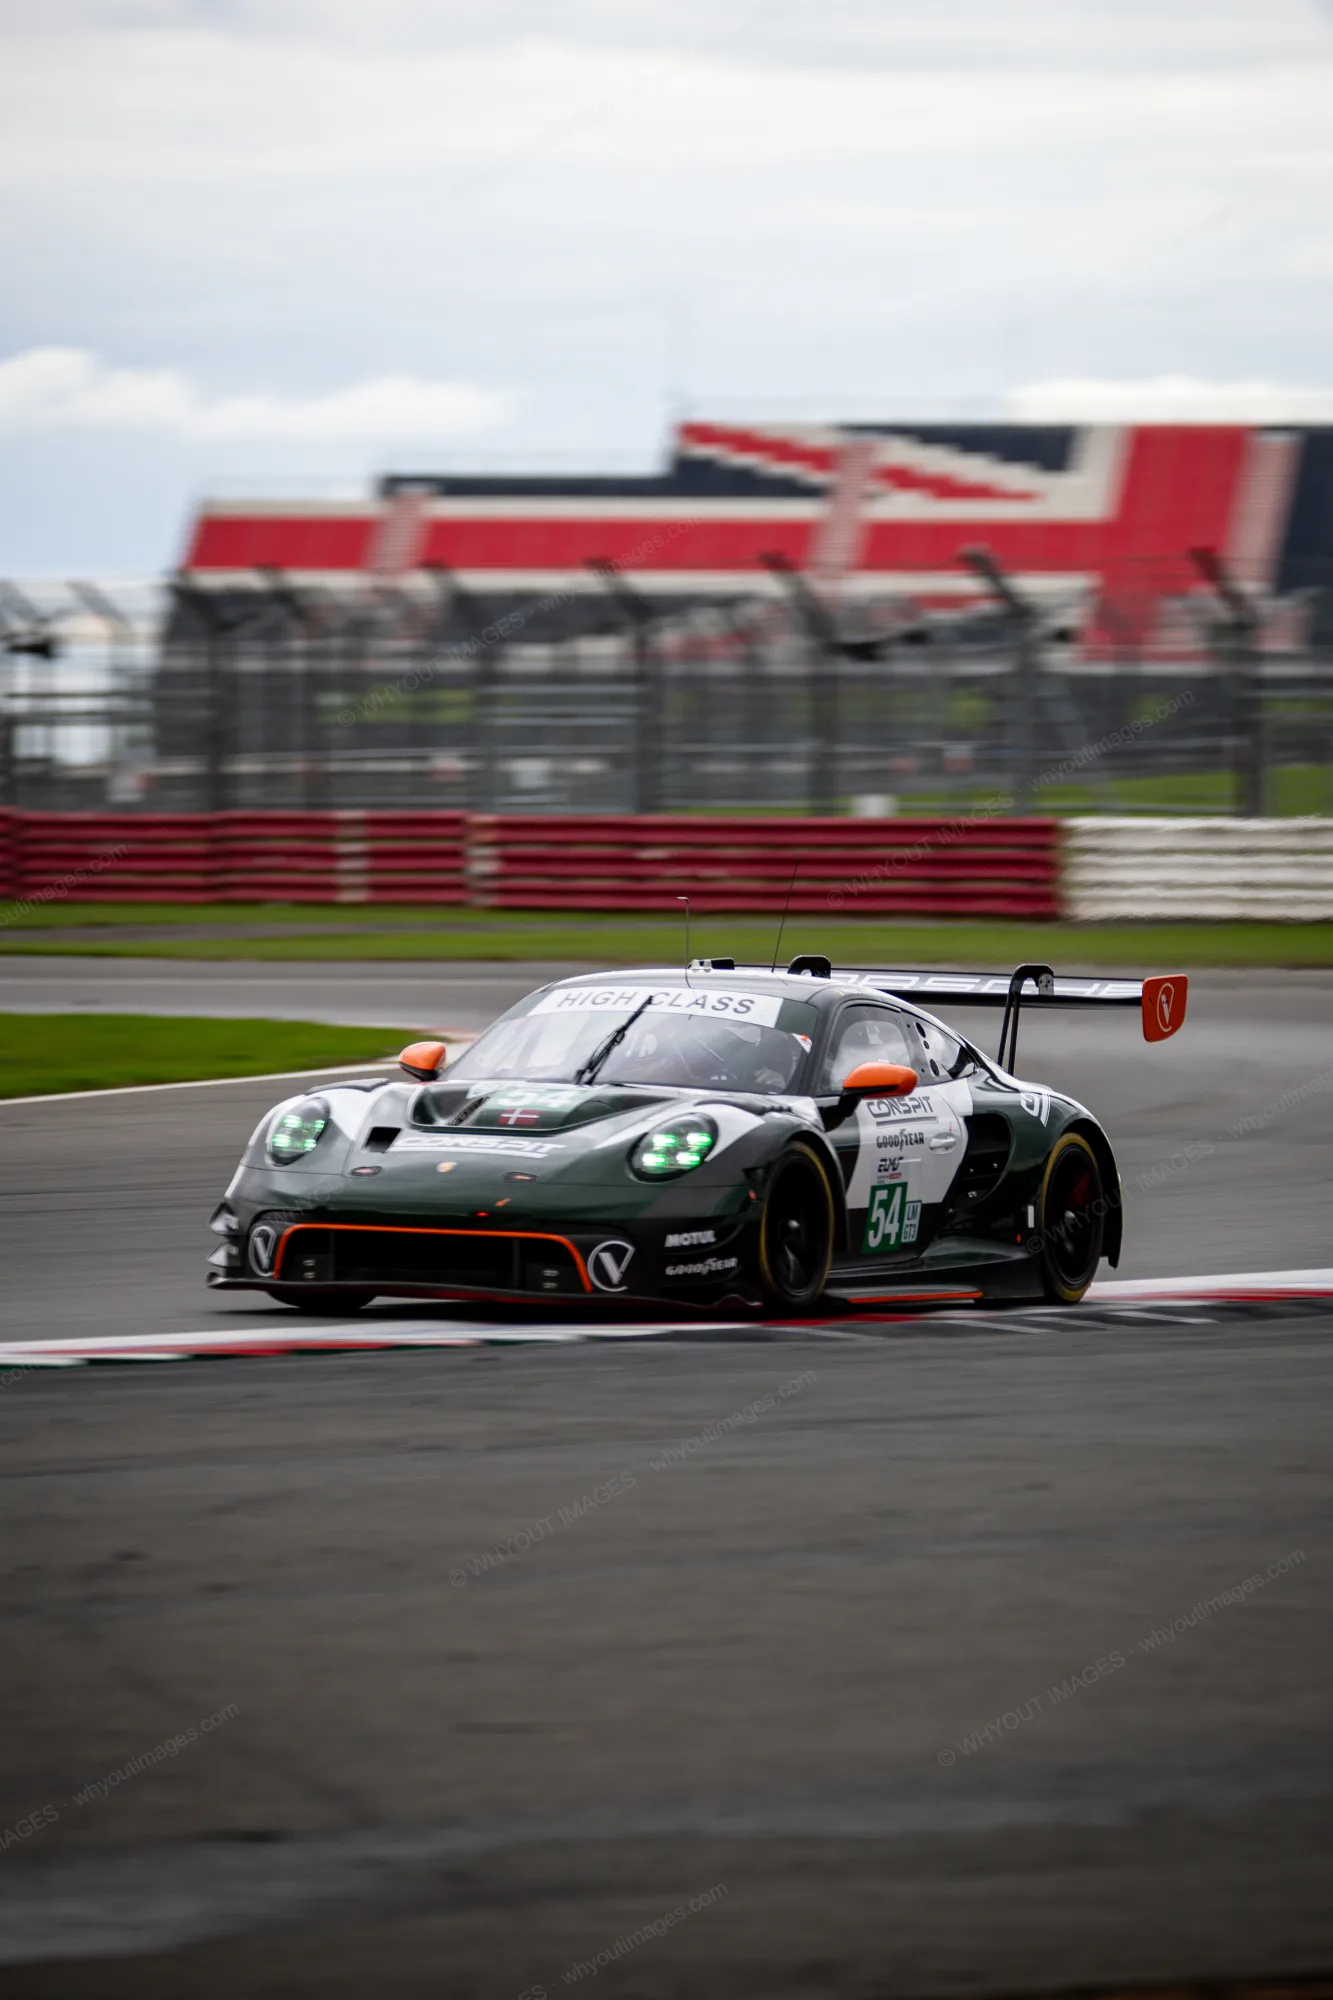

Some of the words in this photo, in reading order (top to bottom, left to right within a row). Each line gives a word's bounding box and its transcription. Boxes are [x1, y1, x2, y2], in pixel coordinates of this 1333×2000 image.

[556, 991, 638, 1008] HIGH
[650, 992, 755, 1015] CLASS
[498, 1088, 577, 1109] 54
[399, 1136, 567, 1153] CONSPIT
[877, 1129, 925, 1151] GOODYEAR
[868, 1186, 903, 1247] 54
[664, 1230, 717, 1247] MOTUL
[903, 1223, 917, 1240] GT3
